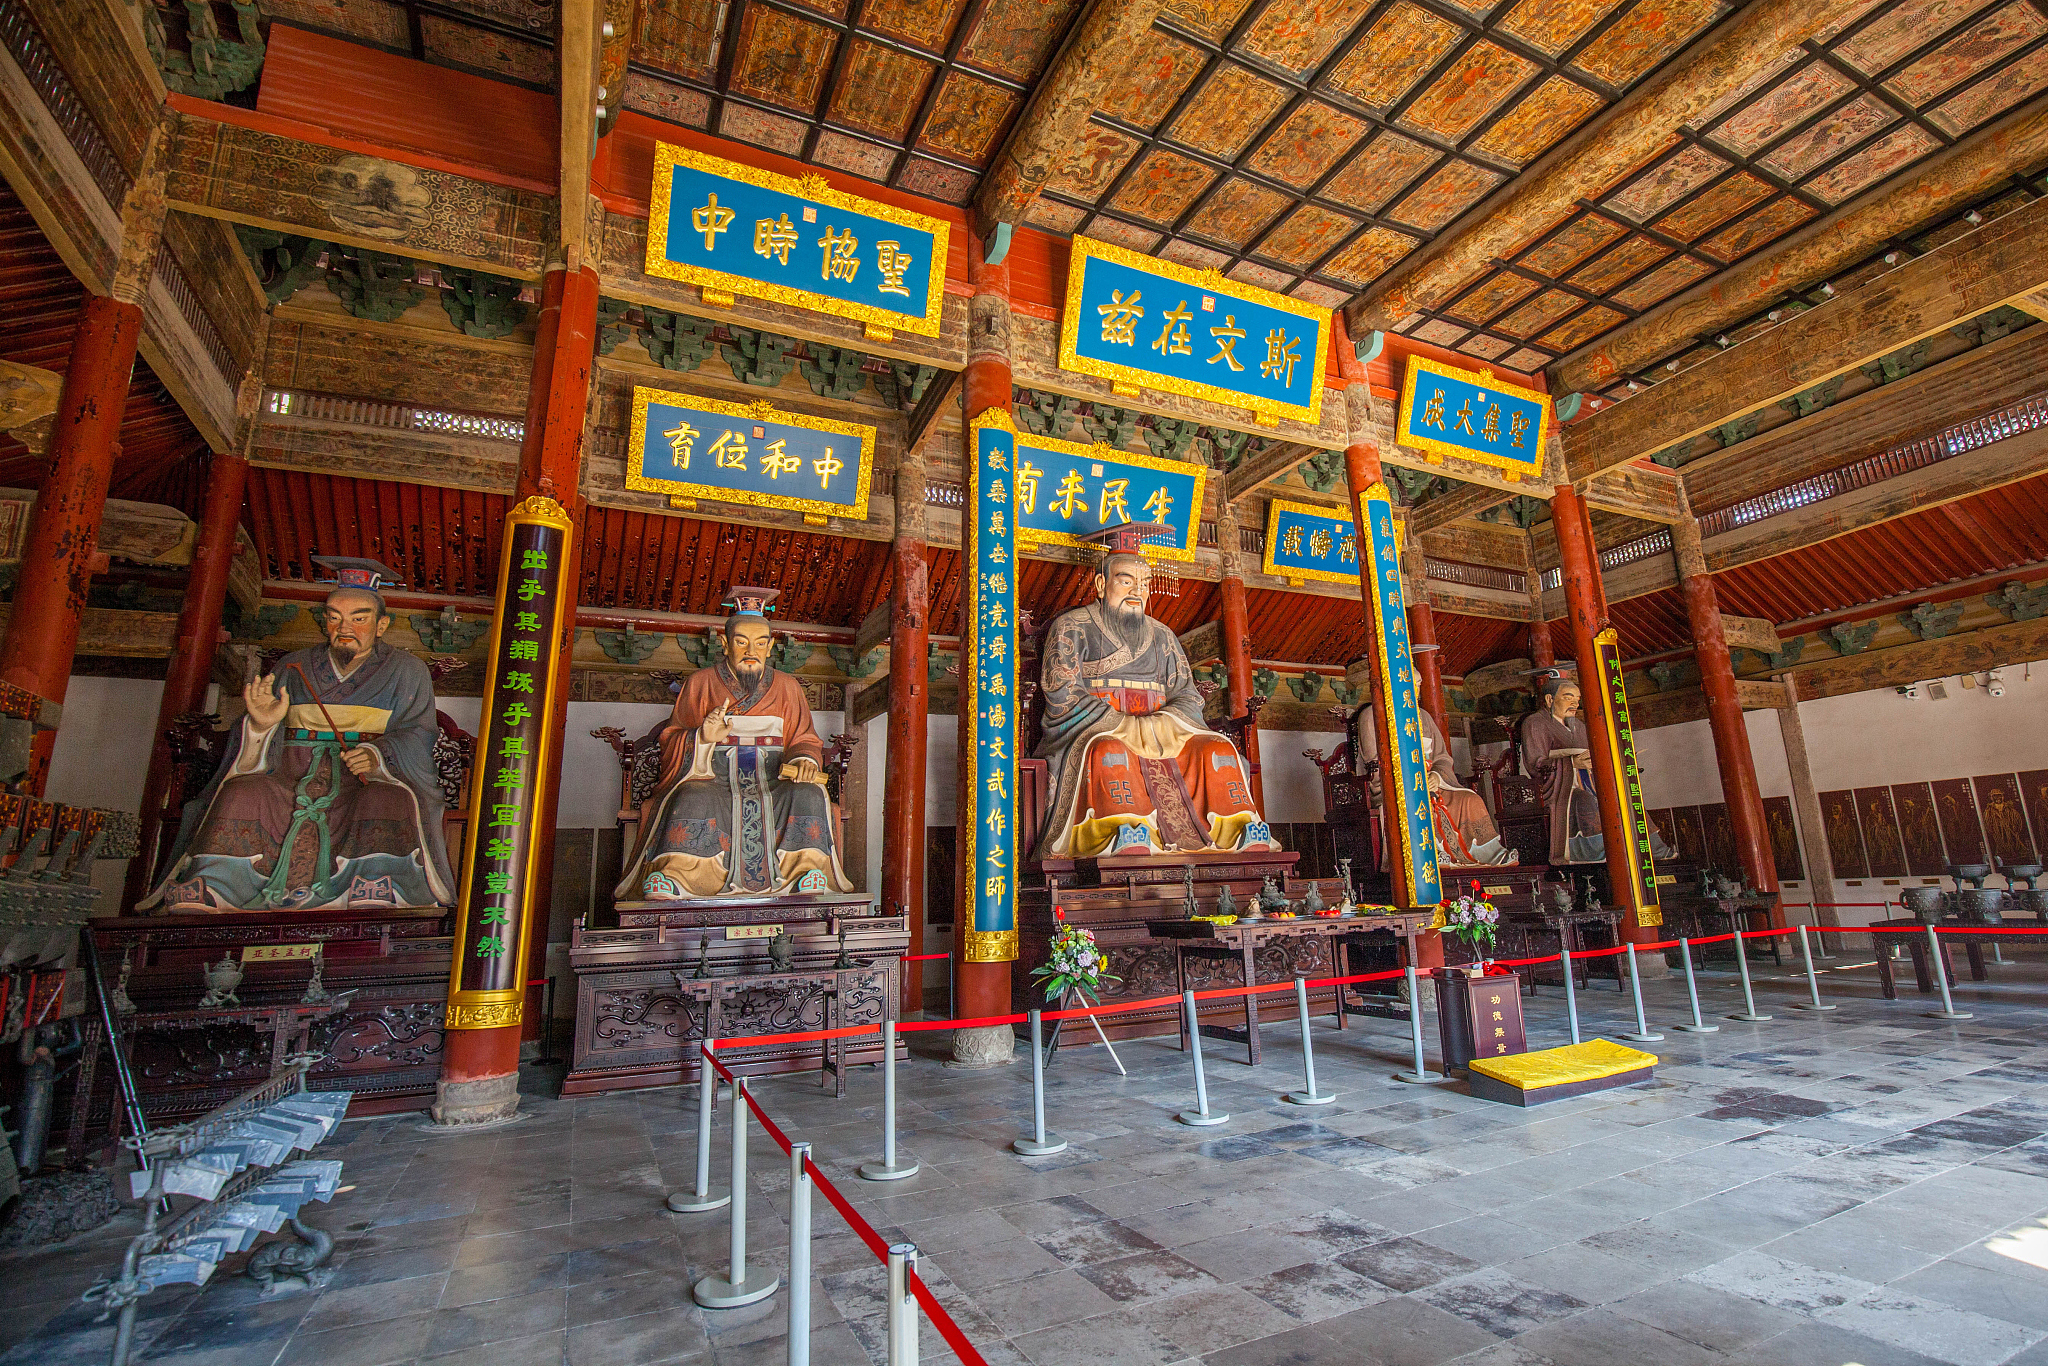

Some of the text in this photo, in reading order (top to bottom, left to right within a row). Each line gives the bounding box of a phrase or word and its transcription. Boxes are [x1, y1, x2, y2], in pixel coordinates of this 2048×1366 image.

[690, 191, 913, 298] 聖協時中
[1420, 387, 1531, 450] 聖集大成
[662, 420, 845, 491] 中和位育
